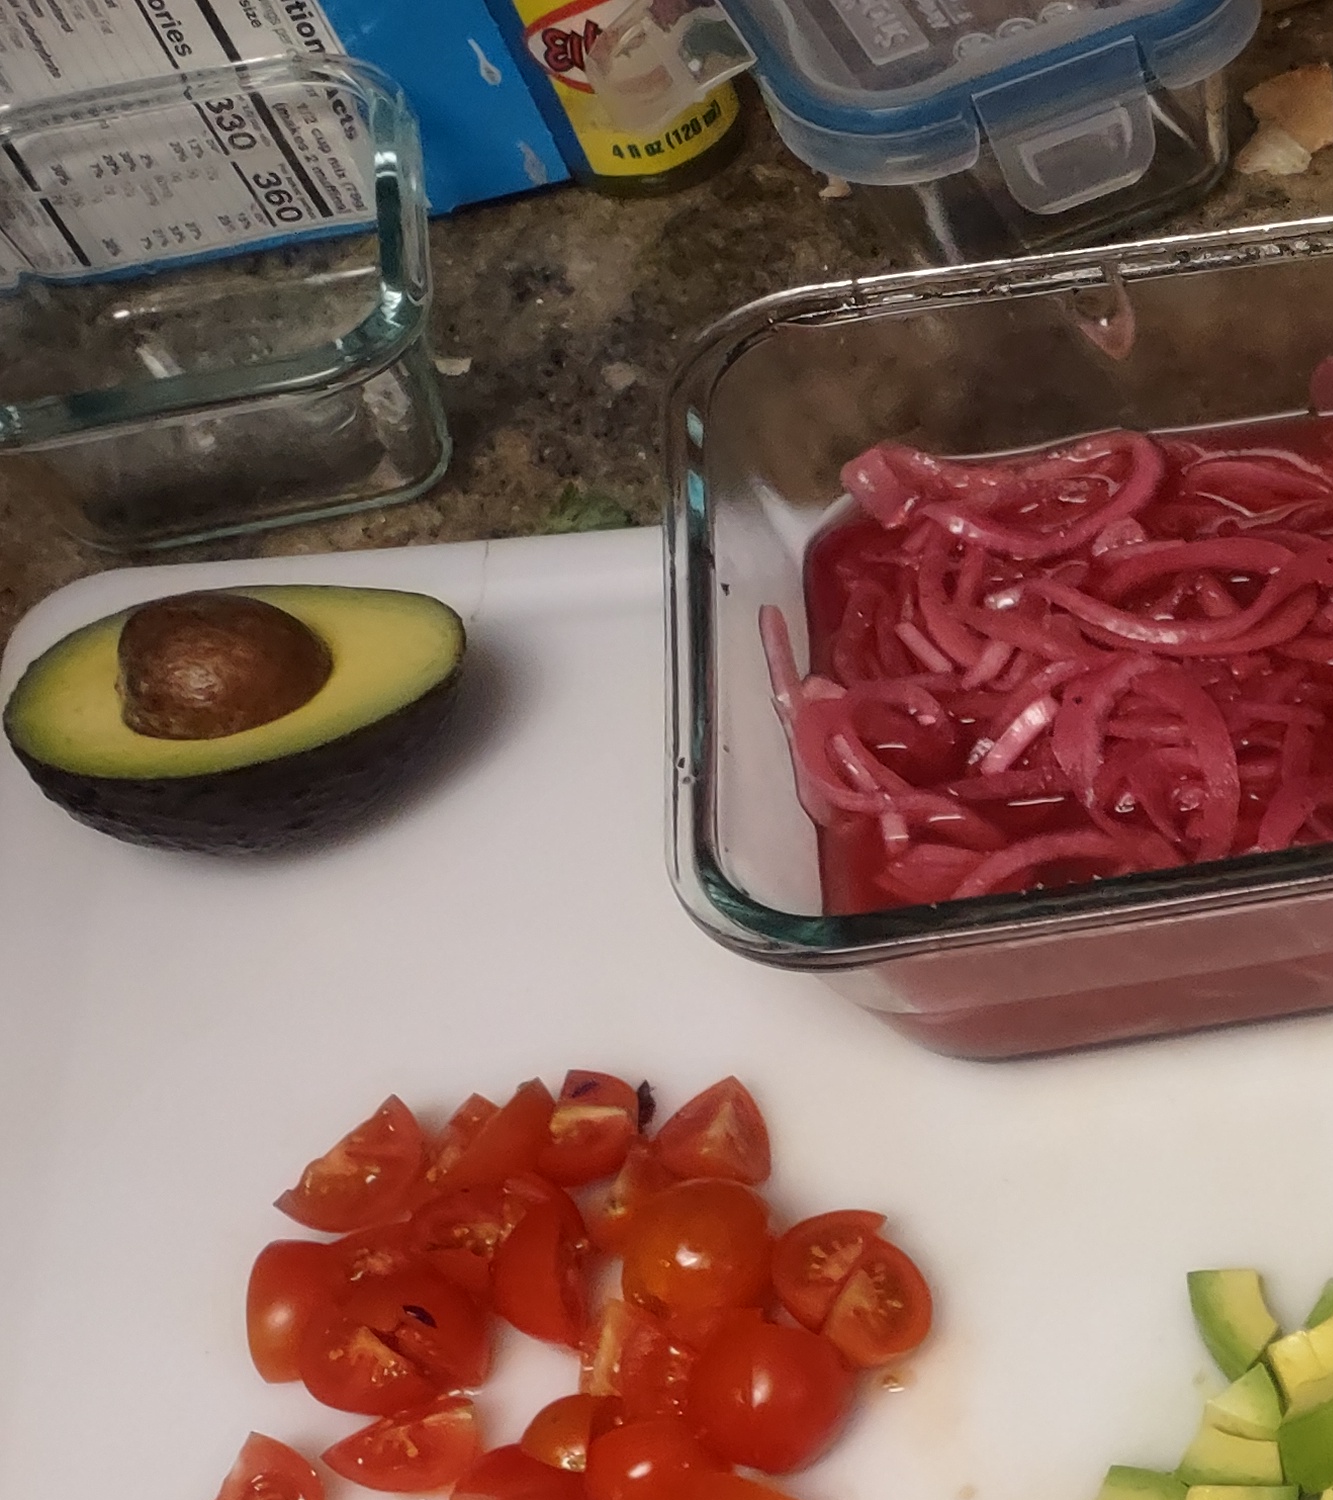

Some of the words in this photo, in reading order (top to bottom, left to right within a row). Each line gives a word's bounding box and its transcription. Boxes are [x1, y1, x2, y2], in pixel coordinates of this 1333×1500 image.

[308, 128, 332, 153] cup
[612, 144, 624, 159] 4
[664, 118, 702, 149] (120
[204, 97, 257, 151] 330
[252, 171, 304, 223] 360
